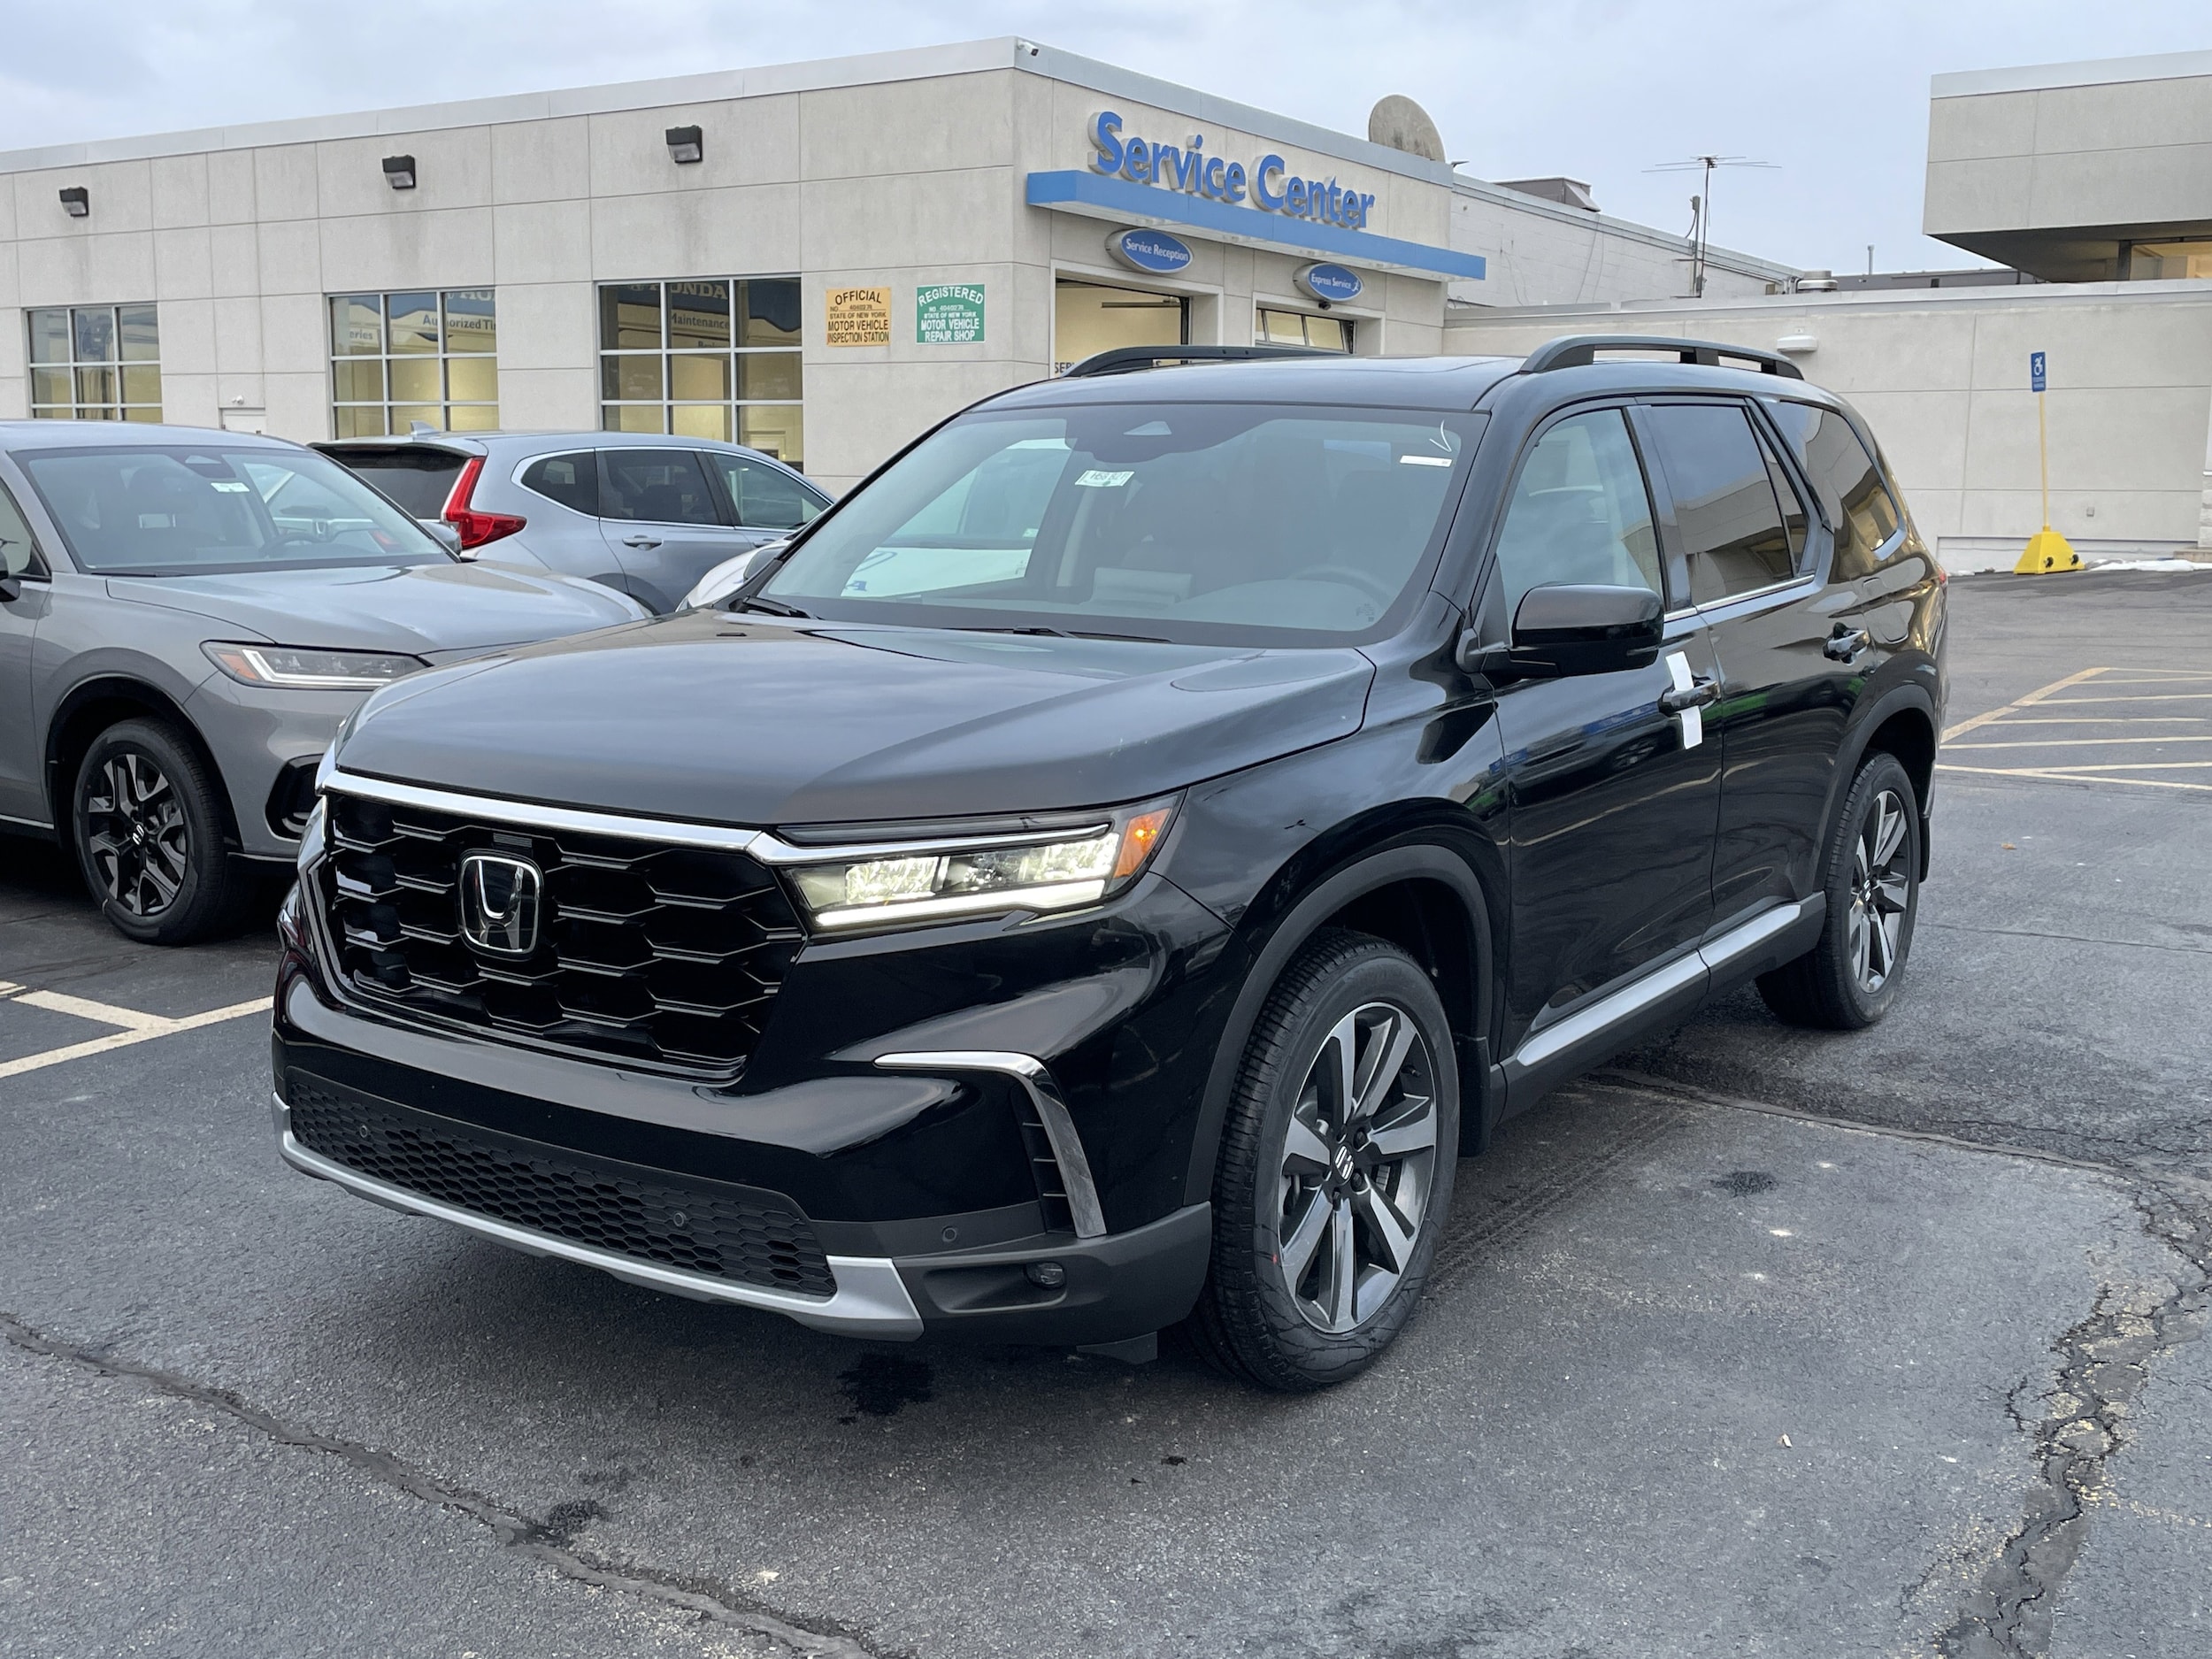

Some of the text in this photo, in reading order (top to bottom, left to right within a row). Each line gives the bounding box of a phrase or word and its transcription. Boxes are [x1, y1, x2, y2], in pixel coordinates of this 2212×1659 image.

[1094, 111, 1375, 229] Service Center
[1125, 238, 1189, 262] Service Reception
[1310, 273, 1352, 290] Express Service
[835, 289, 882, 305] OFFICIAL
[918, 286, 984, 307] REGISTERED
[423, 313, 481, 329] Auorized
[828, 319, 888, 332] MOTOR VEHICLE
[920, 318, 979, 331] MOTOR VEHICLE
[827, 330, 889, 343] INSPECTION STATION
[925, 329, 976, 342] REPAIR SHOP
